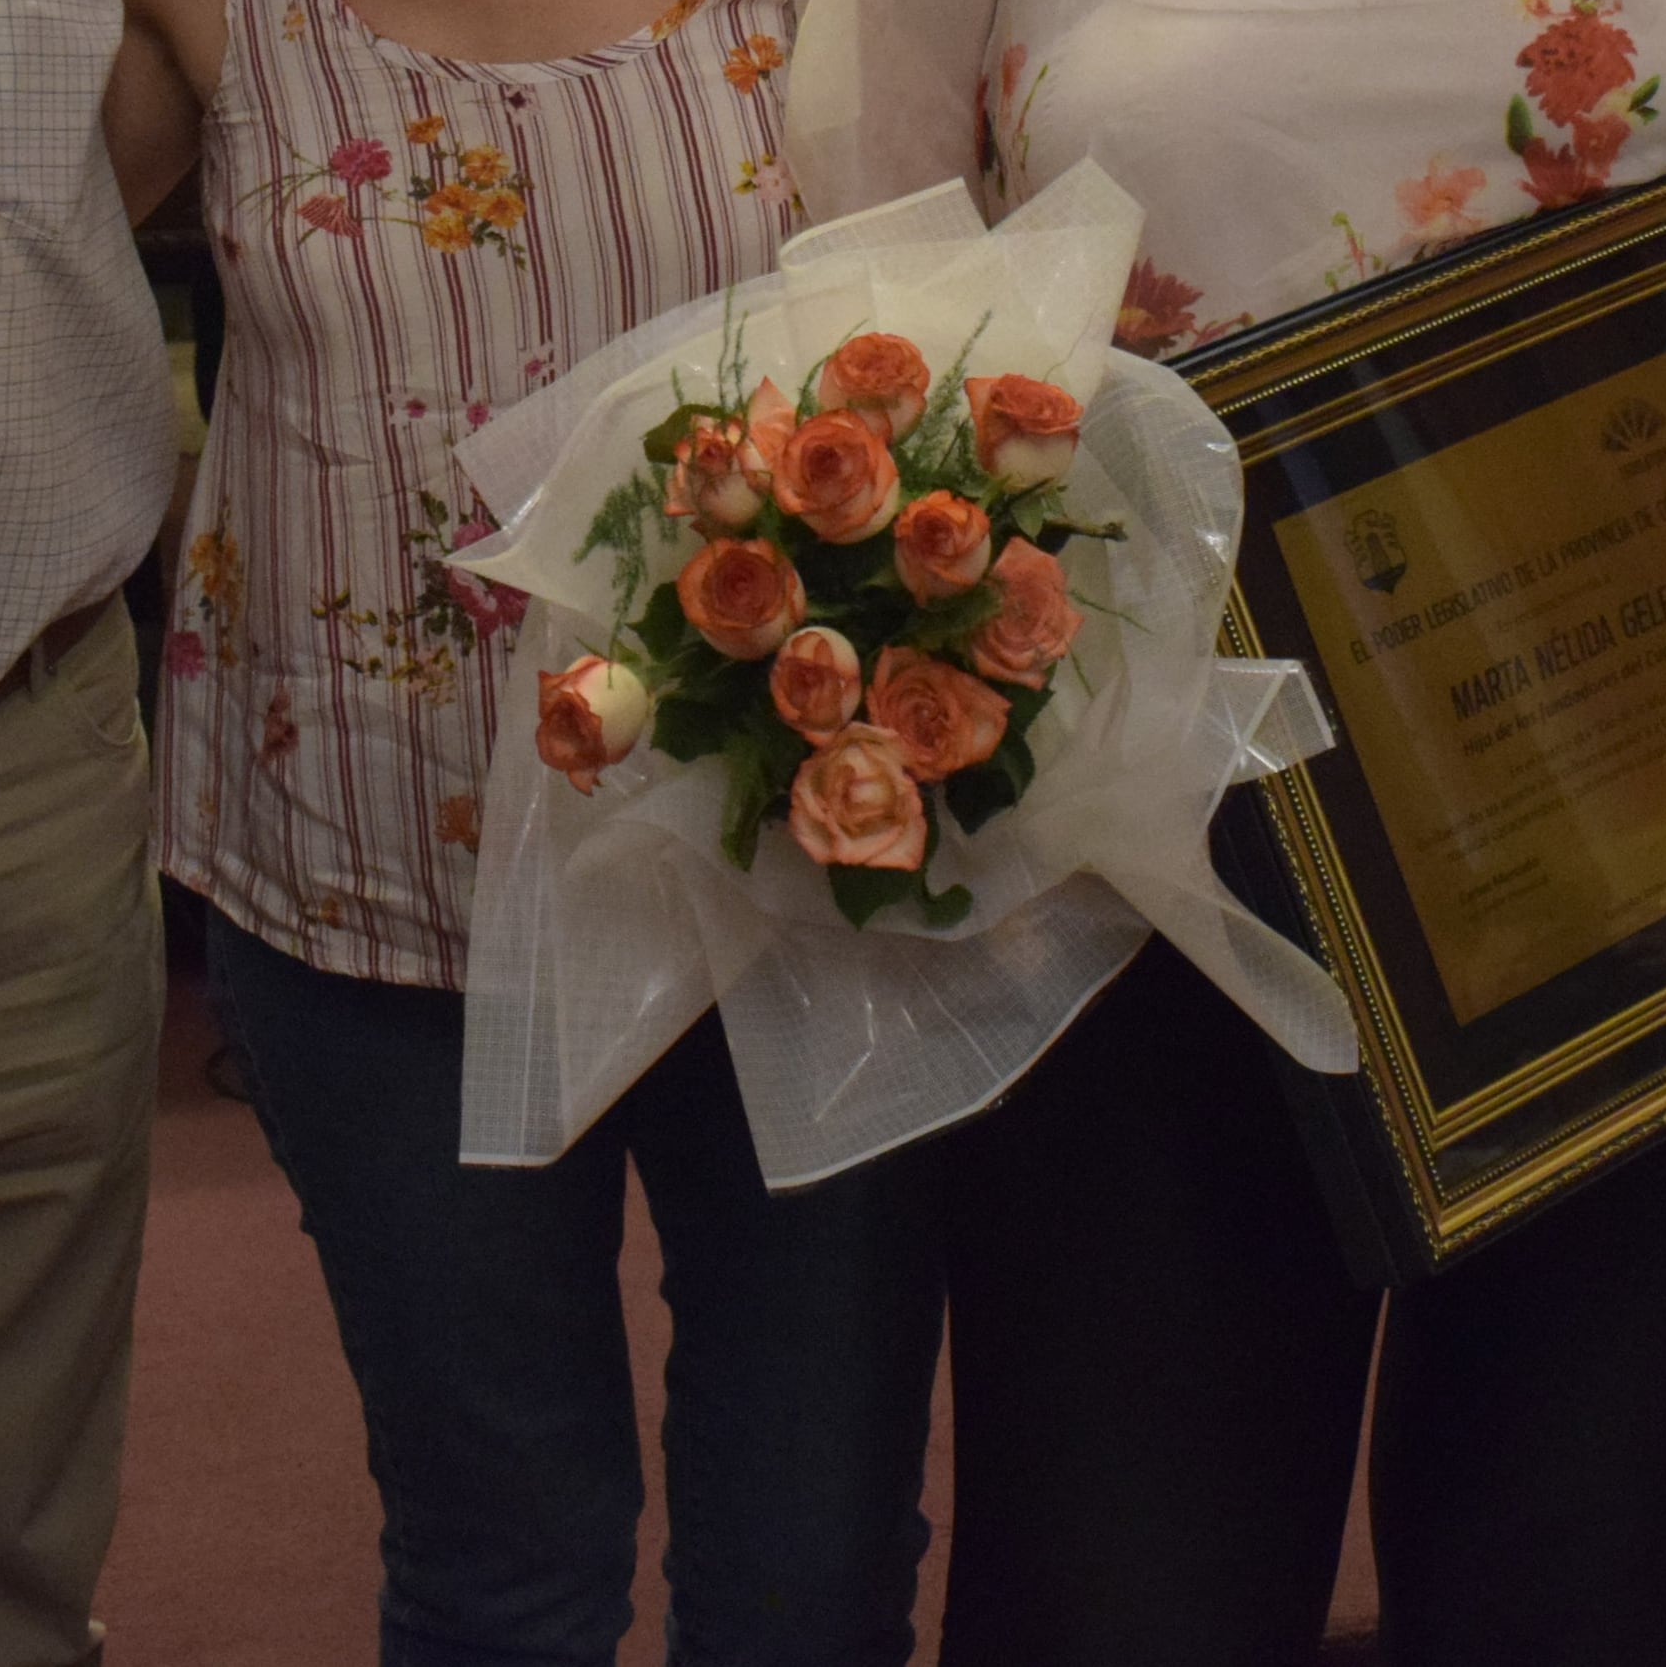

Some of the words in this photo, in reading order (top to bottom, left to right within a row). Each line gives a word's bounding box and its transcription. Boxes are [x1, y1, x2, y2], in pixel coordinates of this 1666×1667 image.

[1349, 637, 1371, 664] EL
[1371, 612, 1423, 653] PODER
[1423, 571, 1513, 629] LEGISLATIVO
[1510, 559, 1539, 589] DE
[1557, 516, 1633, 567] PROVINCIA
[1446, 654, 1531, 722] MARTA
[1526, 605, 1617, 682] NÉLIDA
